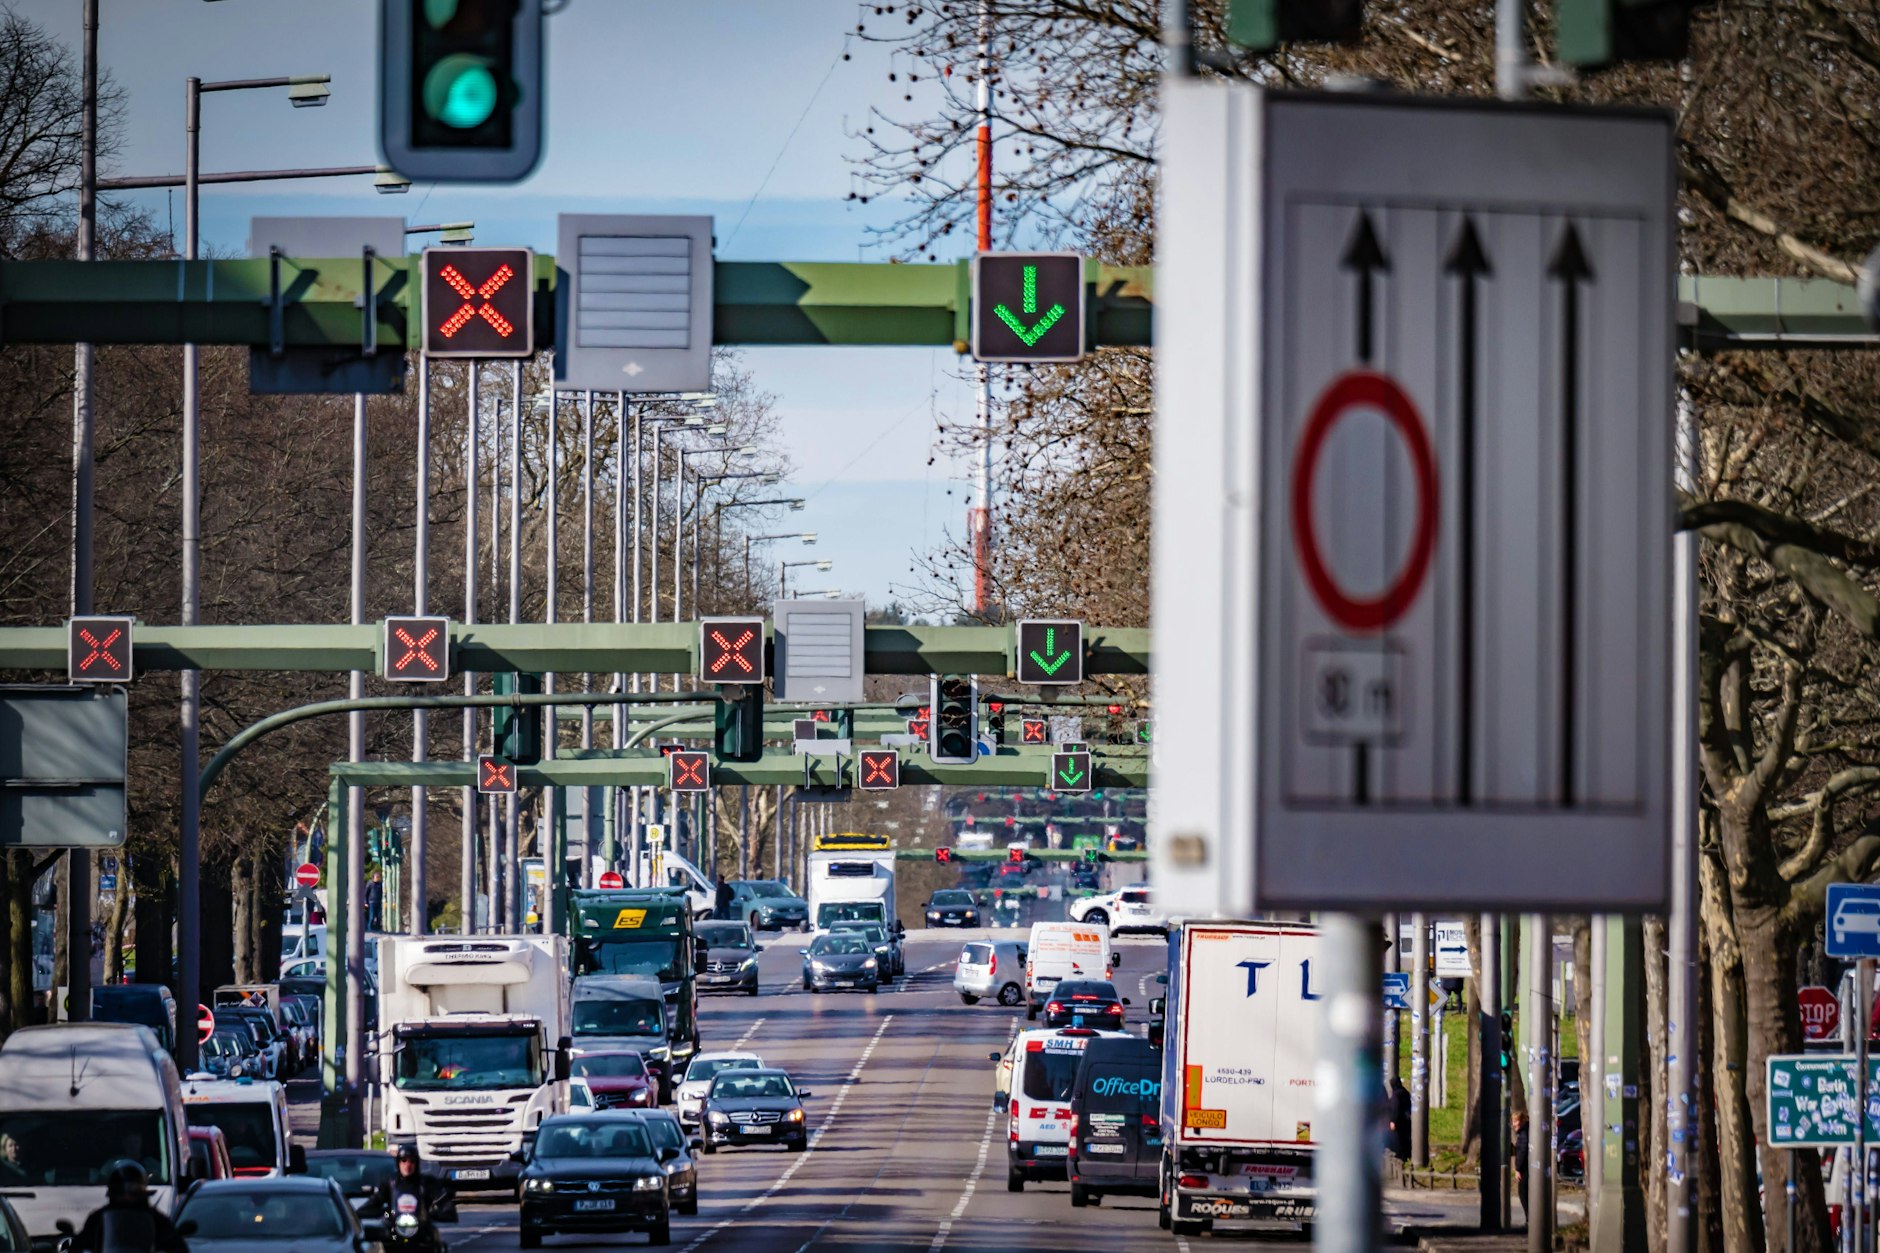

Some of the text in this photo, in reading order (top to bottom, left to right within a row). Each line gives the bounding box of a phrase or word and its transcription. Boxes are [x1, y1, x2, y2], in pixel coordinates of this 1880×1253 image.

[618, 917, 642, 926] ES
[1235, 957, 1276, 998] T
[1046, 1039, 1074, 1049] SMH
[444, 1095, 494, 1105] SCANIA
[1245, 1165, 1294, 1174] FRUEHAUF
[1190, 1202, 1249, 1217] ROQUES
